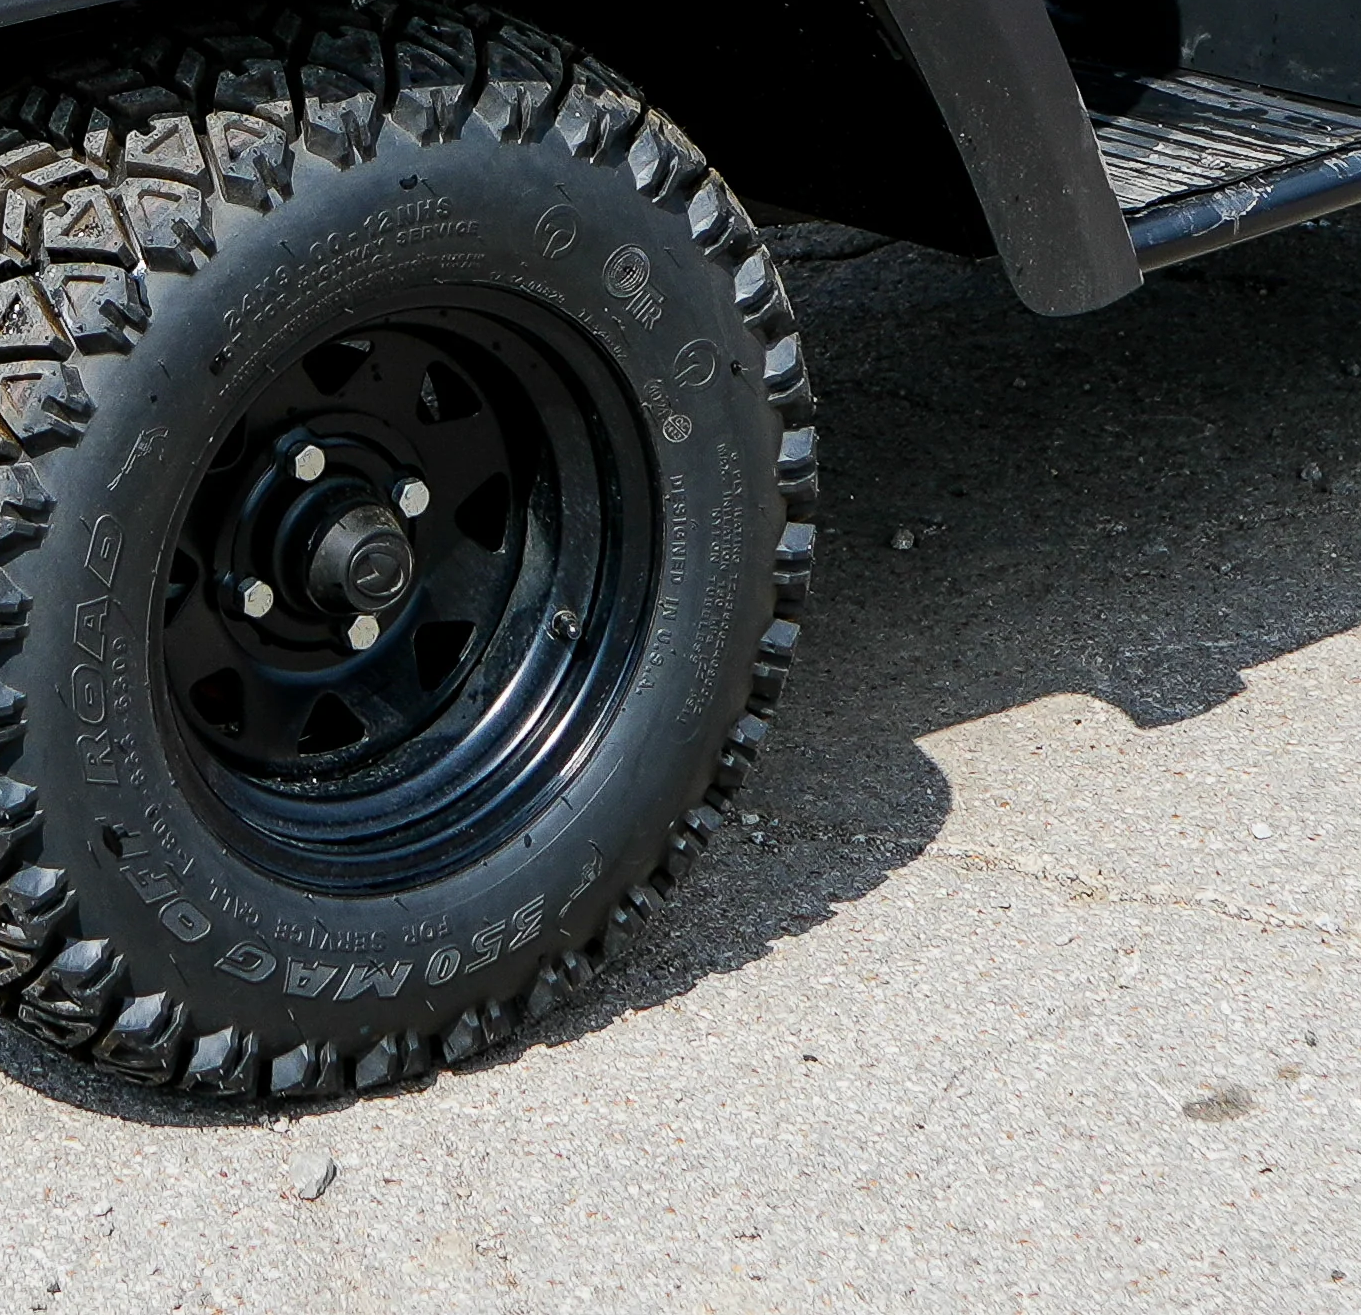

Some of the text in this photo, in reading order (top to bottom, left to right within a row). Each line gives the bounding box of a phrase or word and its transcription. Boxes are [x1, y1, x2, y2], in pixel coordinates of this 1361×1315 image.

[396, 218, 481, 247] SERVICE
[668, 473, 690, 586] DESIGNED
[659, 596, 682, 623] IN
[70, 512, 124, 786] ROAD
[205, 877, 262, 931] CALL
[400, 914, 453, 947] FOR
[271, 915, 388, 954] SERVICE
[423, 892, 546, 988] 350
[213, 939, 414, 1003] MAG
